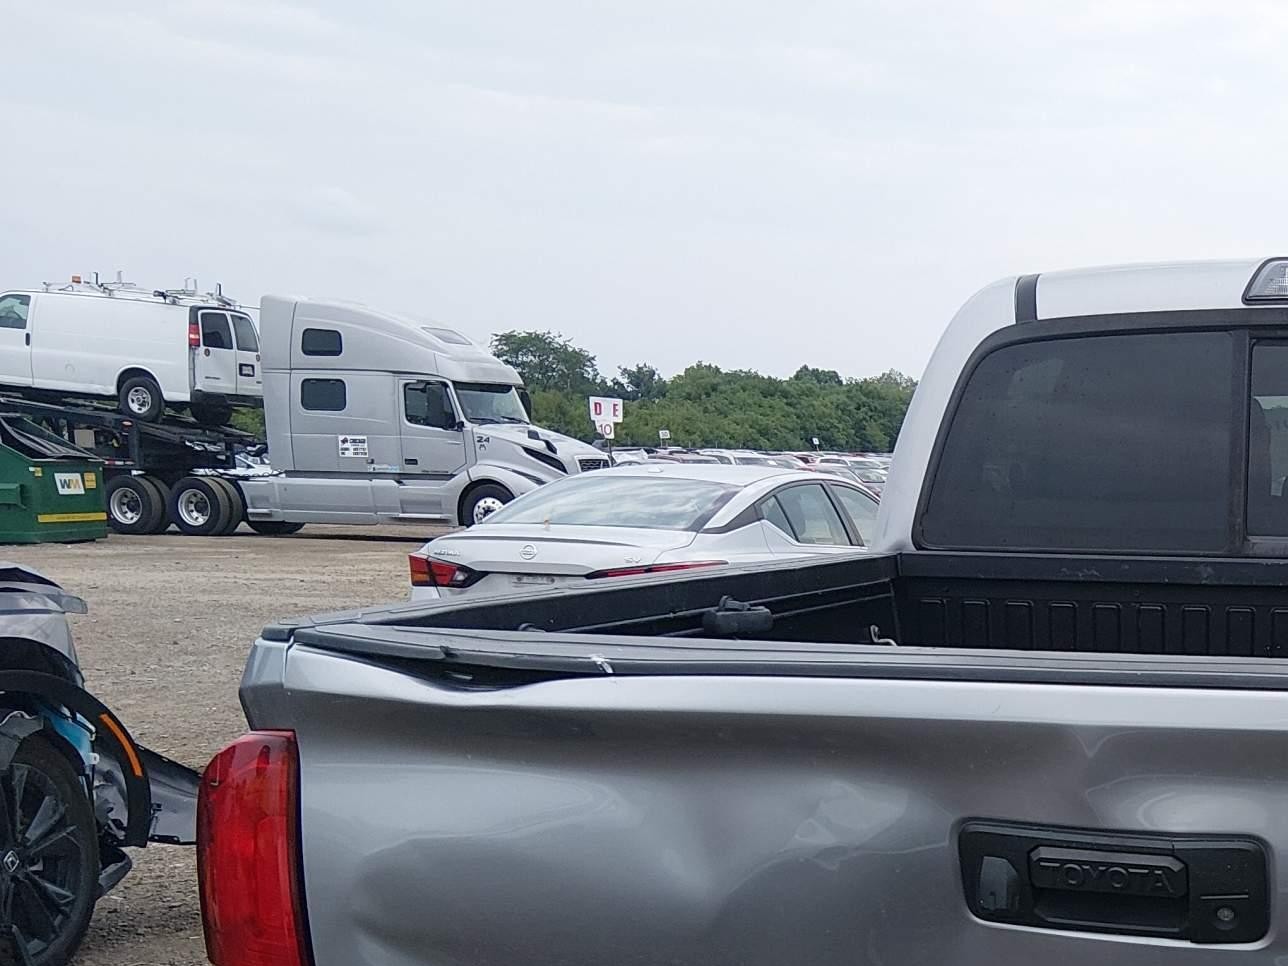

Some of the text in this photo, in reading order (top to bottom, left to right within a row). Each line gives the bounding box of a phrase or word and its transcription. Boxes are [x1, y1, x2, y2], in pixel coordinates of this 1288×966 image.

[594, 402, 619, 417] D E
[599, 423, 612, 436] 10
[476, 435, 490, 444] 24
[59, 478, 81, 490] WM
[1038, 861, 1174, 893] TOYOTA
